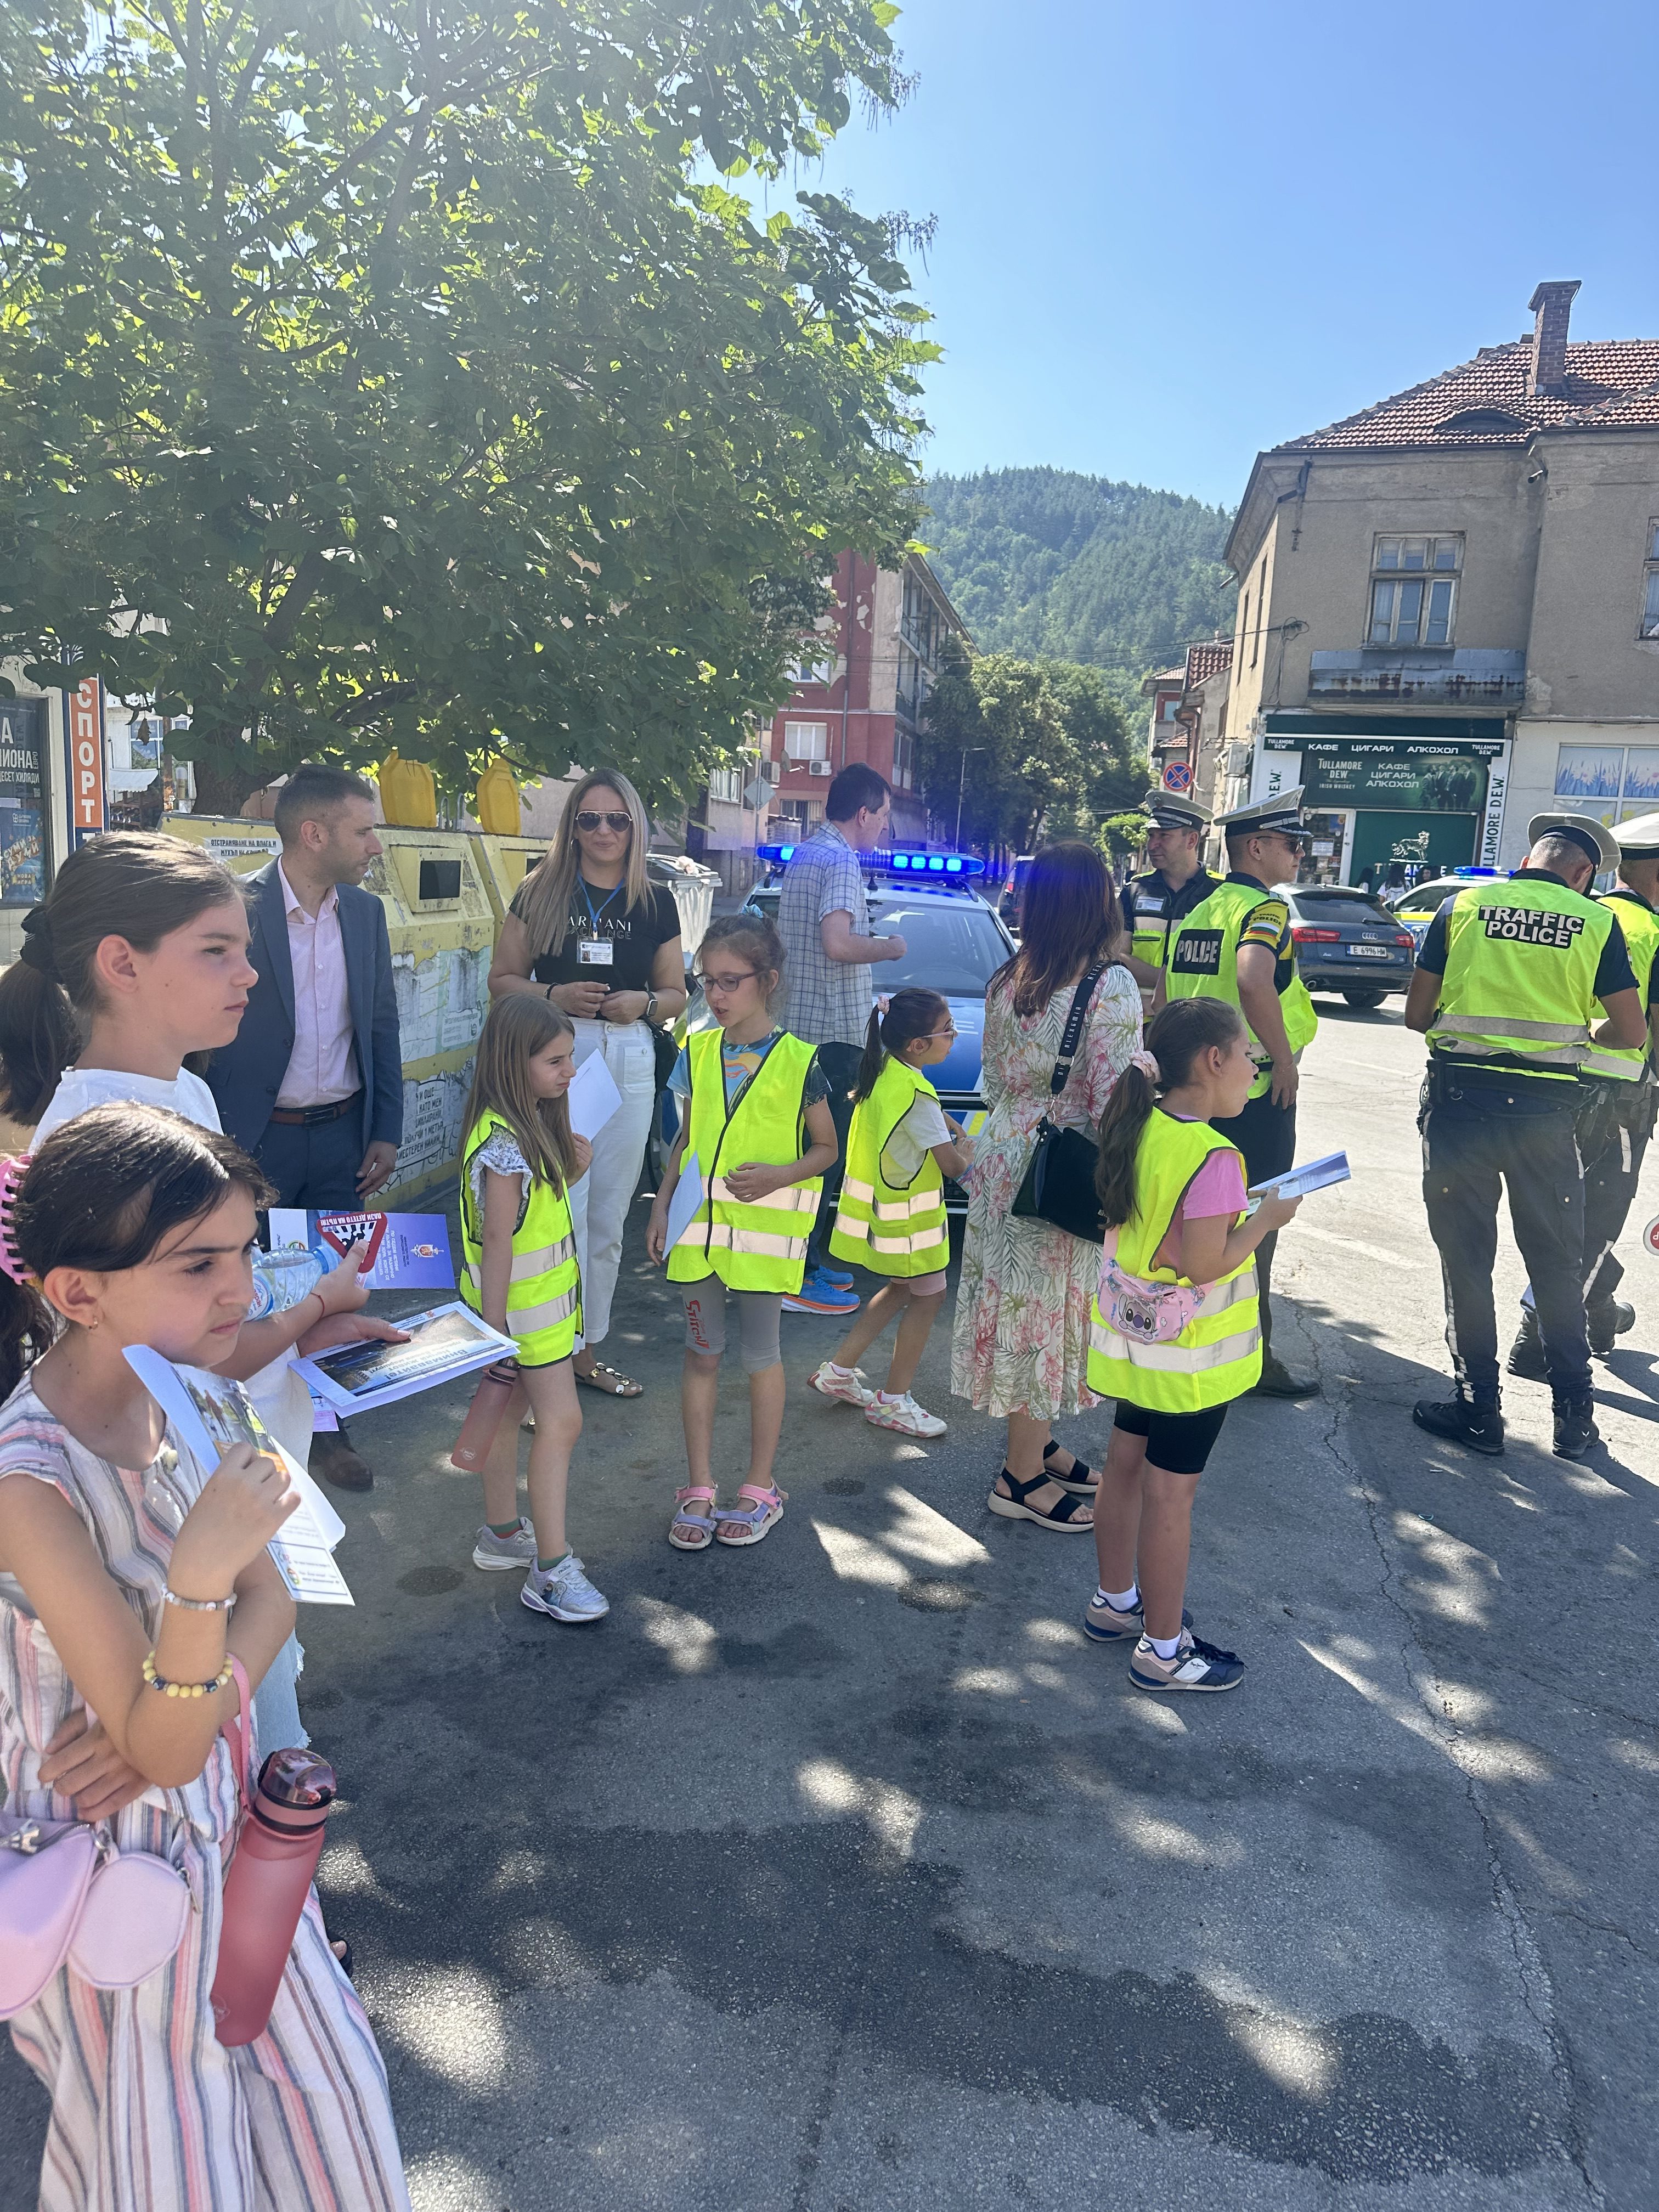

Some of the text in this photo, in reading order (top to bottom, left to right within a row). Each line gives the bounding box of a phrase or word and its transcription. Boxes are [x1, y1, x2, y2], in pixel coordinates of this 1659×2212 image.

[76, 682, 95, 822] СПОРТ
[1351, 744, 1394, 753] ЦИГАРИ
[1407, 746, 1459, 754] АЛКОХОЛ
[1365, 780, 1419, 788] АЛКОХОЛ
[1370, 771, 1416, 780] ЦИГАРИ
[1482, 812, 1500, 867] LLAMORE
[567, 916, 631, 932] ARANI
[1480, 906, 1583, 932] TRAFFIC
[1487, 921, 1570, 946] POLICE
[1175, 940, 1219, 963] POLICE
[1361, 947, 1376, 955] 6996
[346, 1214, 366, 1223] ДЕТЕТО
[384, 1349, 468, 1380] Внимавайте!
